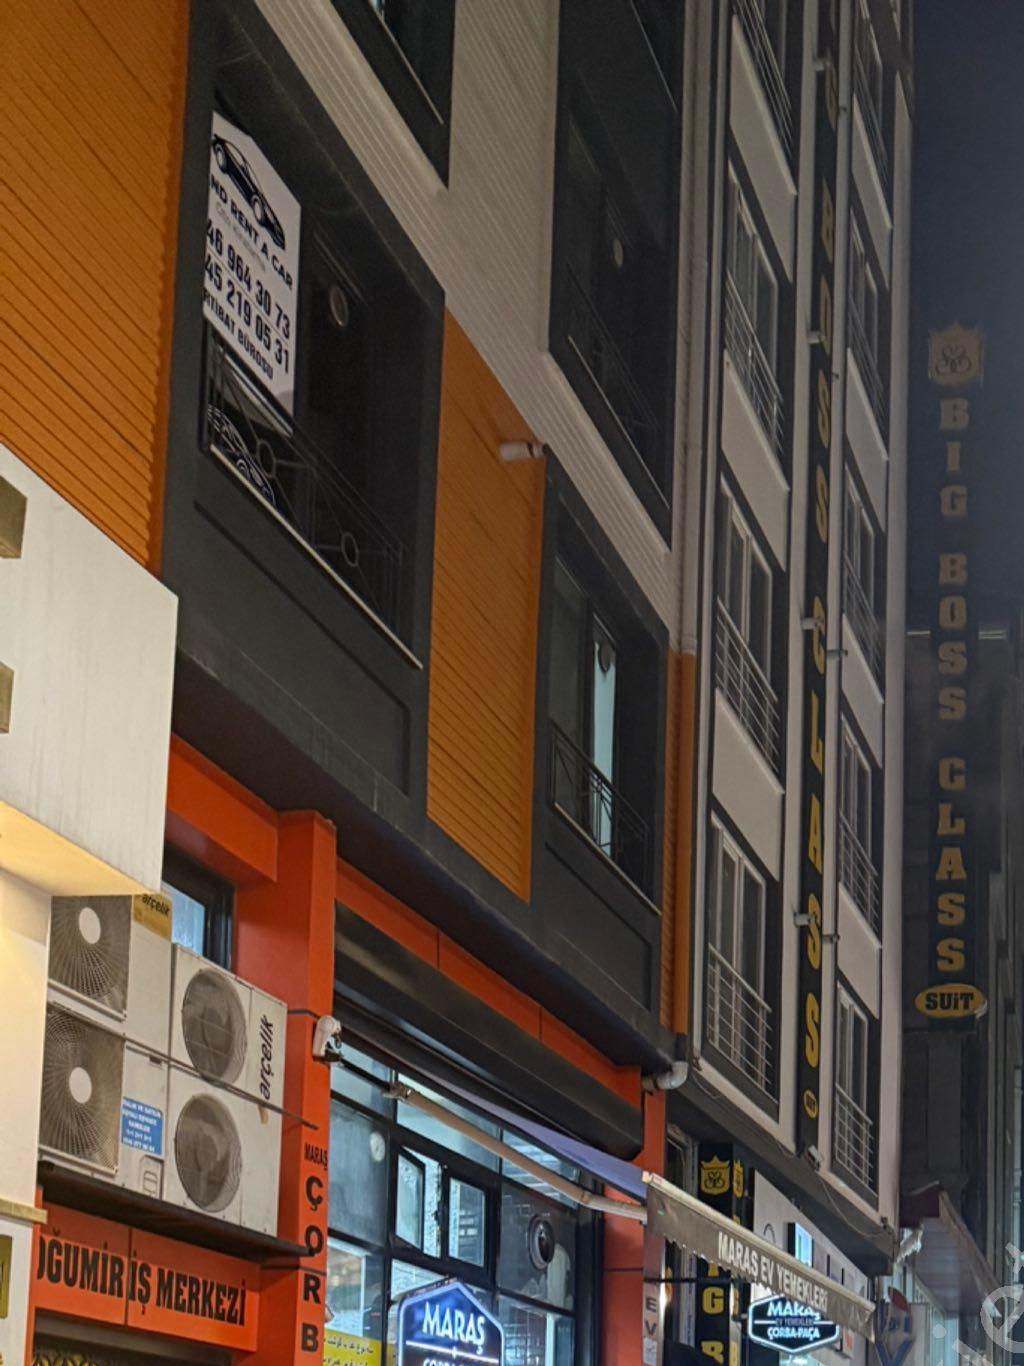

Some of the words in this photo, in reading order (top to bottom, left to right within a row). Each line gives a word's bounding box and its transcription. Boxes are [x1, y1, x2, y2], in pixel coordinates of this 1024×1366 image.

[230, 199, 260, 246] RENT
[261, 242, 270, 260] A
[272, 254, 293, 290] CAR
[227, 244, 252, 292] 964
[255, 279, 271, 317] 30
[275, 303, 290, 340] 73
[227, 279, 252, 328] 219
[255, 315, 272, 350] 05
[274, 339, 290, 375] 31
[939, 398, 969, 518] BIG
[938, 552, 968, 721] BOSS
[936, 756, 968, 973] CLASS
[258, 1013, 275, 1101] arçelik
[304, 1143, 328, 1172] MARAŞ
[127, 1251, 151, 1315] İŞ
[156, 1268, 247, 1327] MERKEZİ
[718, 1231, 759, 1279] MARAŞ
[760, 1255, 776, 1286] EV
[422, 1301, 486, 1355] MARAŞ
[645, 1297, 658, 1336] EV
[767, 1326, 820, 1341] ÇORBA-PAÇA
